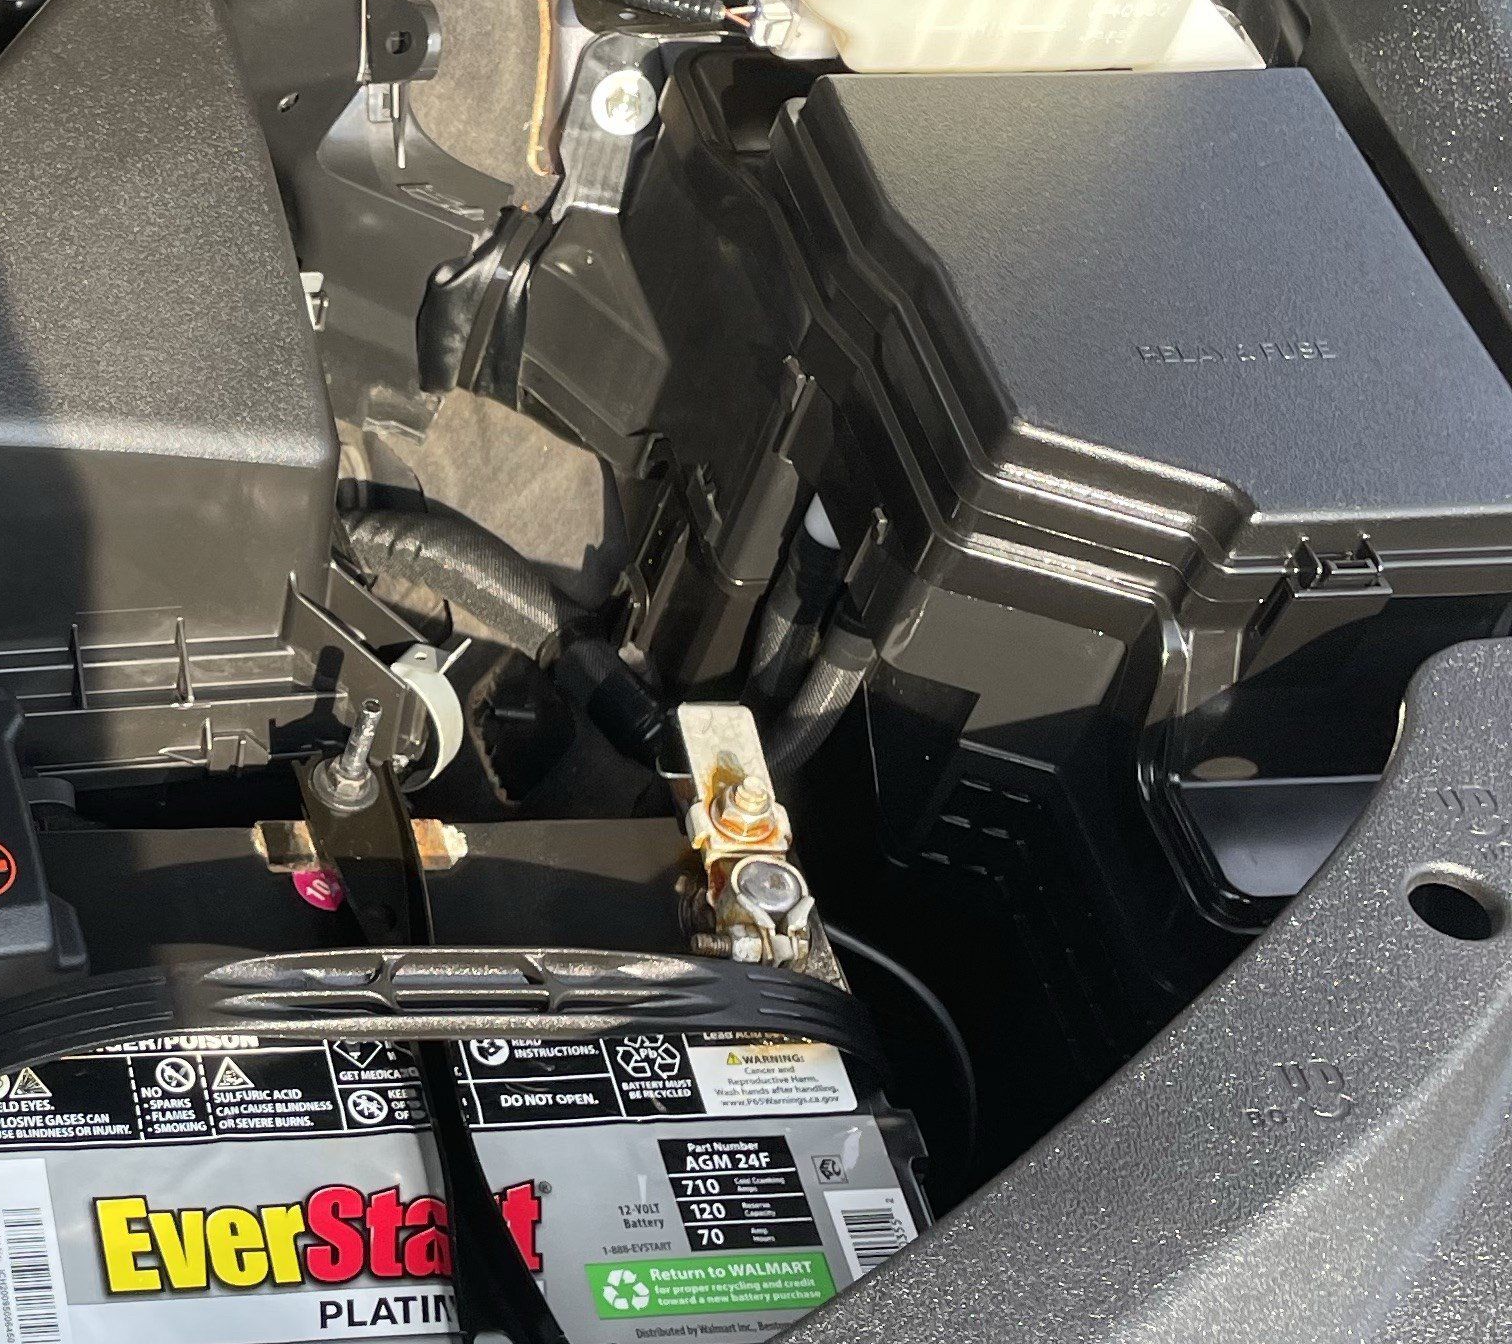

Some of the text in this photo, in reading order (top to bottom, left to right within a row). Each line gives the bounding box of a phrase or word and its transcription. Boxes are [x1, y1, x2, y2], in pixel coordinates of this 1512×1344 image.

[1259, 340, 1338, 362] FUSE
[514, 1045, 599, 1058] INSTRUCTIONS.
[639, 1048, 658, 1060] Pb
[742, 1053, 805, 1064] WARNING:
[339, 1069, 402, 1081] GET MEDICA
[621, 1078, 692, 1092] BATTERY MUST
[140, 1087, 163, 1099] NO
[212, 1088, 303, 1103] SULFURIC ACID
[500, 1093, 600, 1107] DO NOT OPEN.
[629, 1088, 692, 1100] BE RECYCLED
[20, 1099, 56, 1111] EYES.
[150, 1098, 192, 1110] SPARKS
[215, 1101, 334, 1117] CAN CAUSE BLINDNESS
[45, 1114, 87, 1126] GASES
[87, 1112, 111, 1124] CAN
[151, 1110, 196, 1122] FLAMES
[218, 1116, 315, 1130] OR SEVERE BURNS.
[15, 1127, 76, 1139] BLINDNESS
[75, 1125, 93, 1137] OR
[92, 1124, 133, 1136] INJURY.
[154, 1121, 209, 1133] SMOKING
[687, 1141, 759, 1154] Part Number
[685, 1152, 771, 1171] AGM 24F
[681, 1178, 721, 1195] 710
[617, 1203, 660, 1215] 12-VOLT
[689, 1203, 727, 1220] 120
[623, 1217, 665, 1230] Battery
[92, 1179, 544, 1295] EverStat
[696, 1228, 726, 1245] 70
[649, 1261, 813, 1281] Return to WALMART
[654, 1277, 816, 1296] for proper recycling and credit
[657, 1289, 822, 1307] toward a new battery purchase
[635, 1326, 686, 1339] Distributed
[687, 1325, 699, 1337] by
[699, 1323, 737, 1335] Walmart
